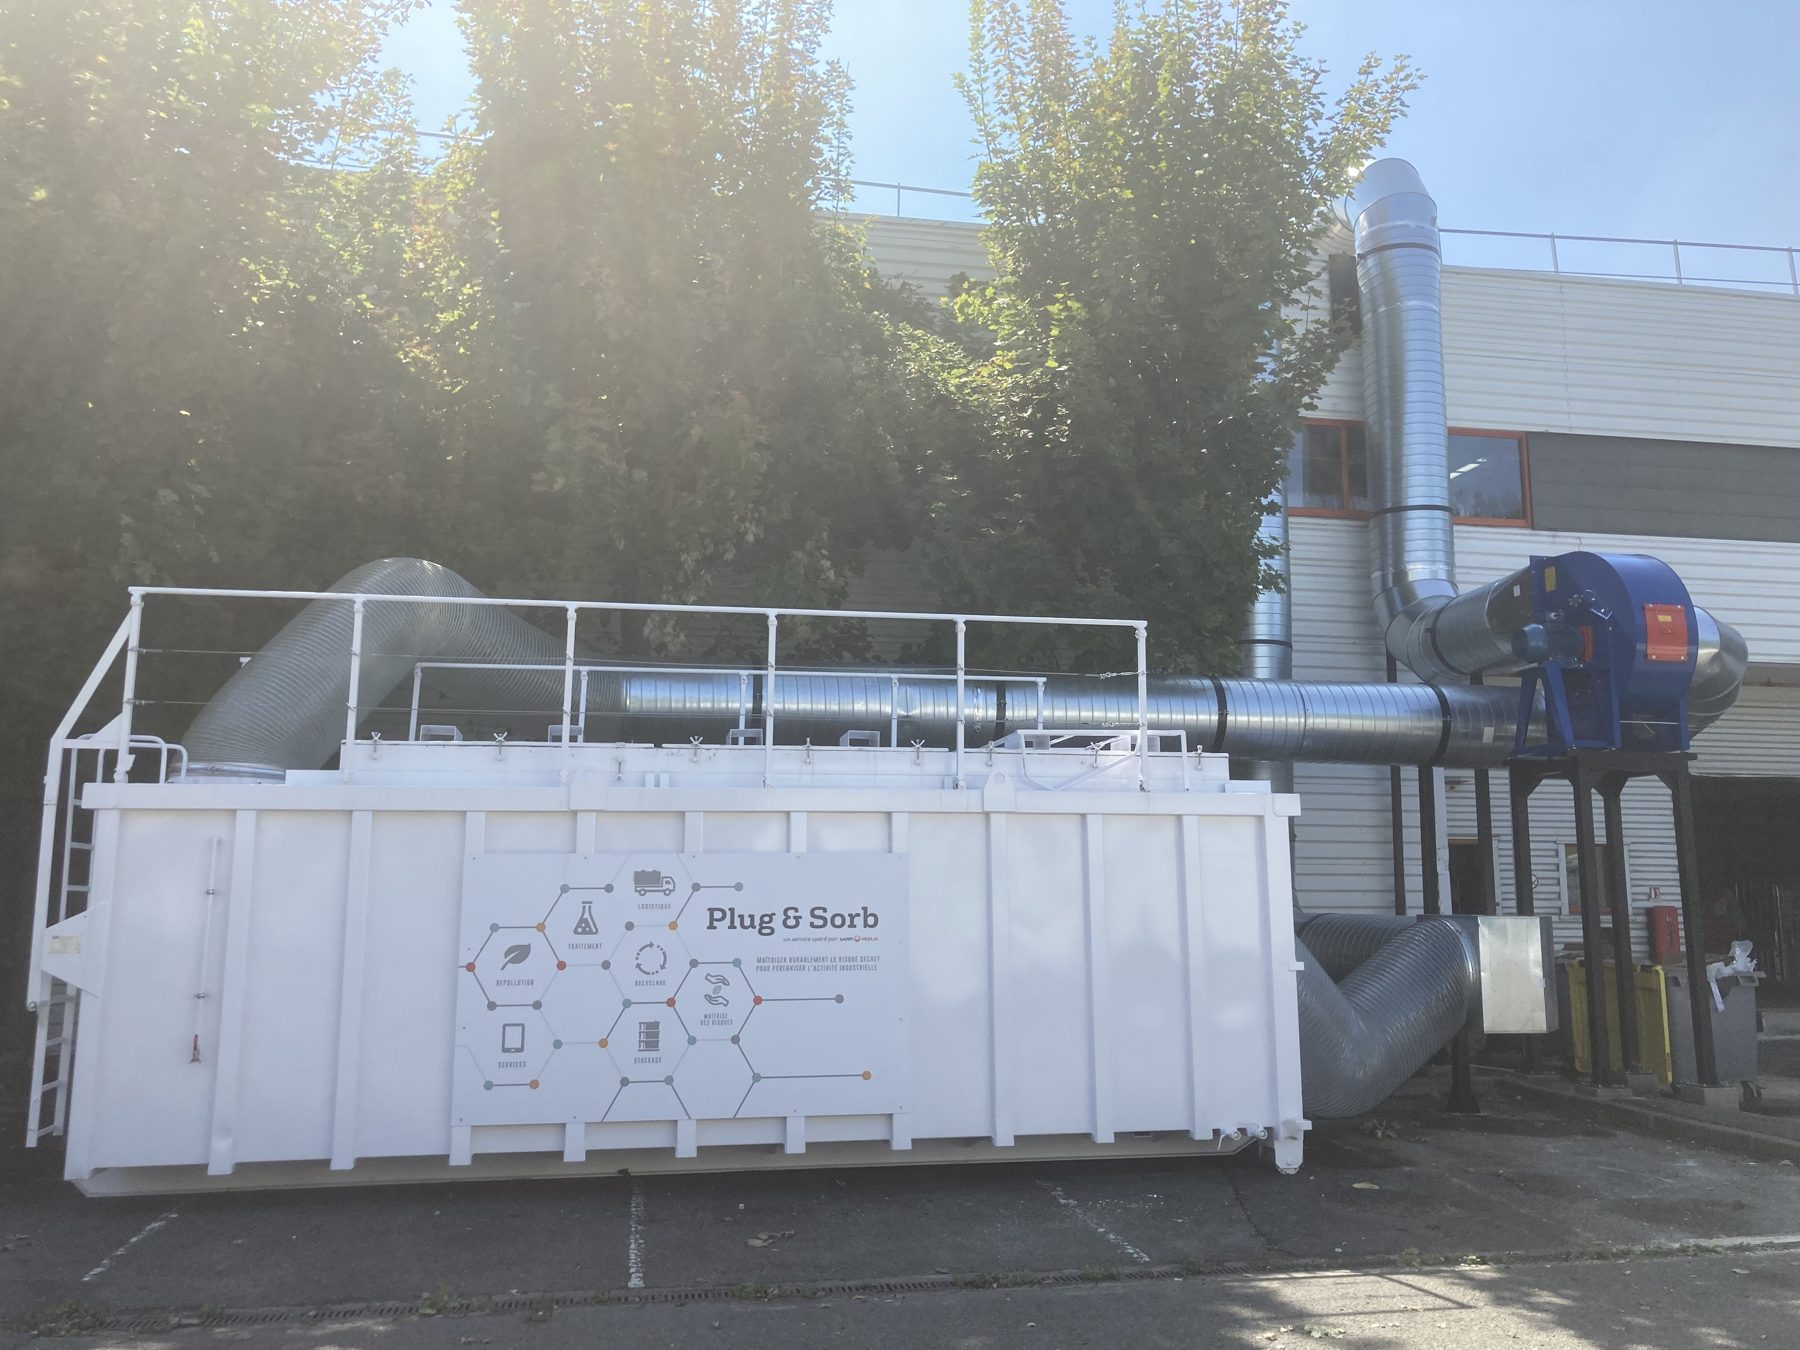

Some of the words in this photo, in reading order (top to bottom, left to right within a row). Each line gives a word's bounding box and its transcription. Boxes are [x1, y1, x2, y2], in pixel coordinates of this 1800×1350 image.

[706, 907, 776, 936] Plug
[782, 906, 802, 929] &
[809, 906, 879, 929] Sorb
[789, 955, 828, 963] DURABLEMENT
[830, 955, 837, 963] LE
[838, 955, 858, 963] RISQUE
[497, 1060, 527, 1069] SERVICES
[633, 1056, 662, 1065] STOCKAGE
